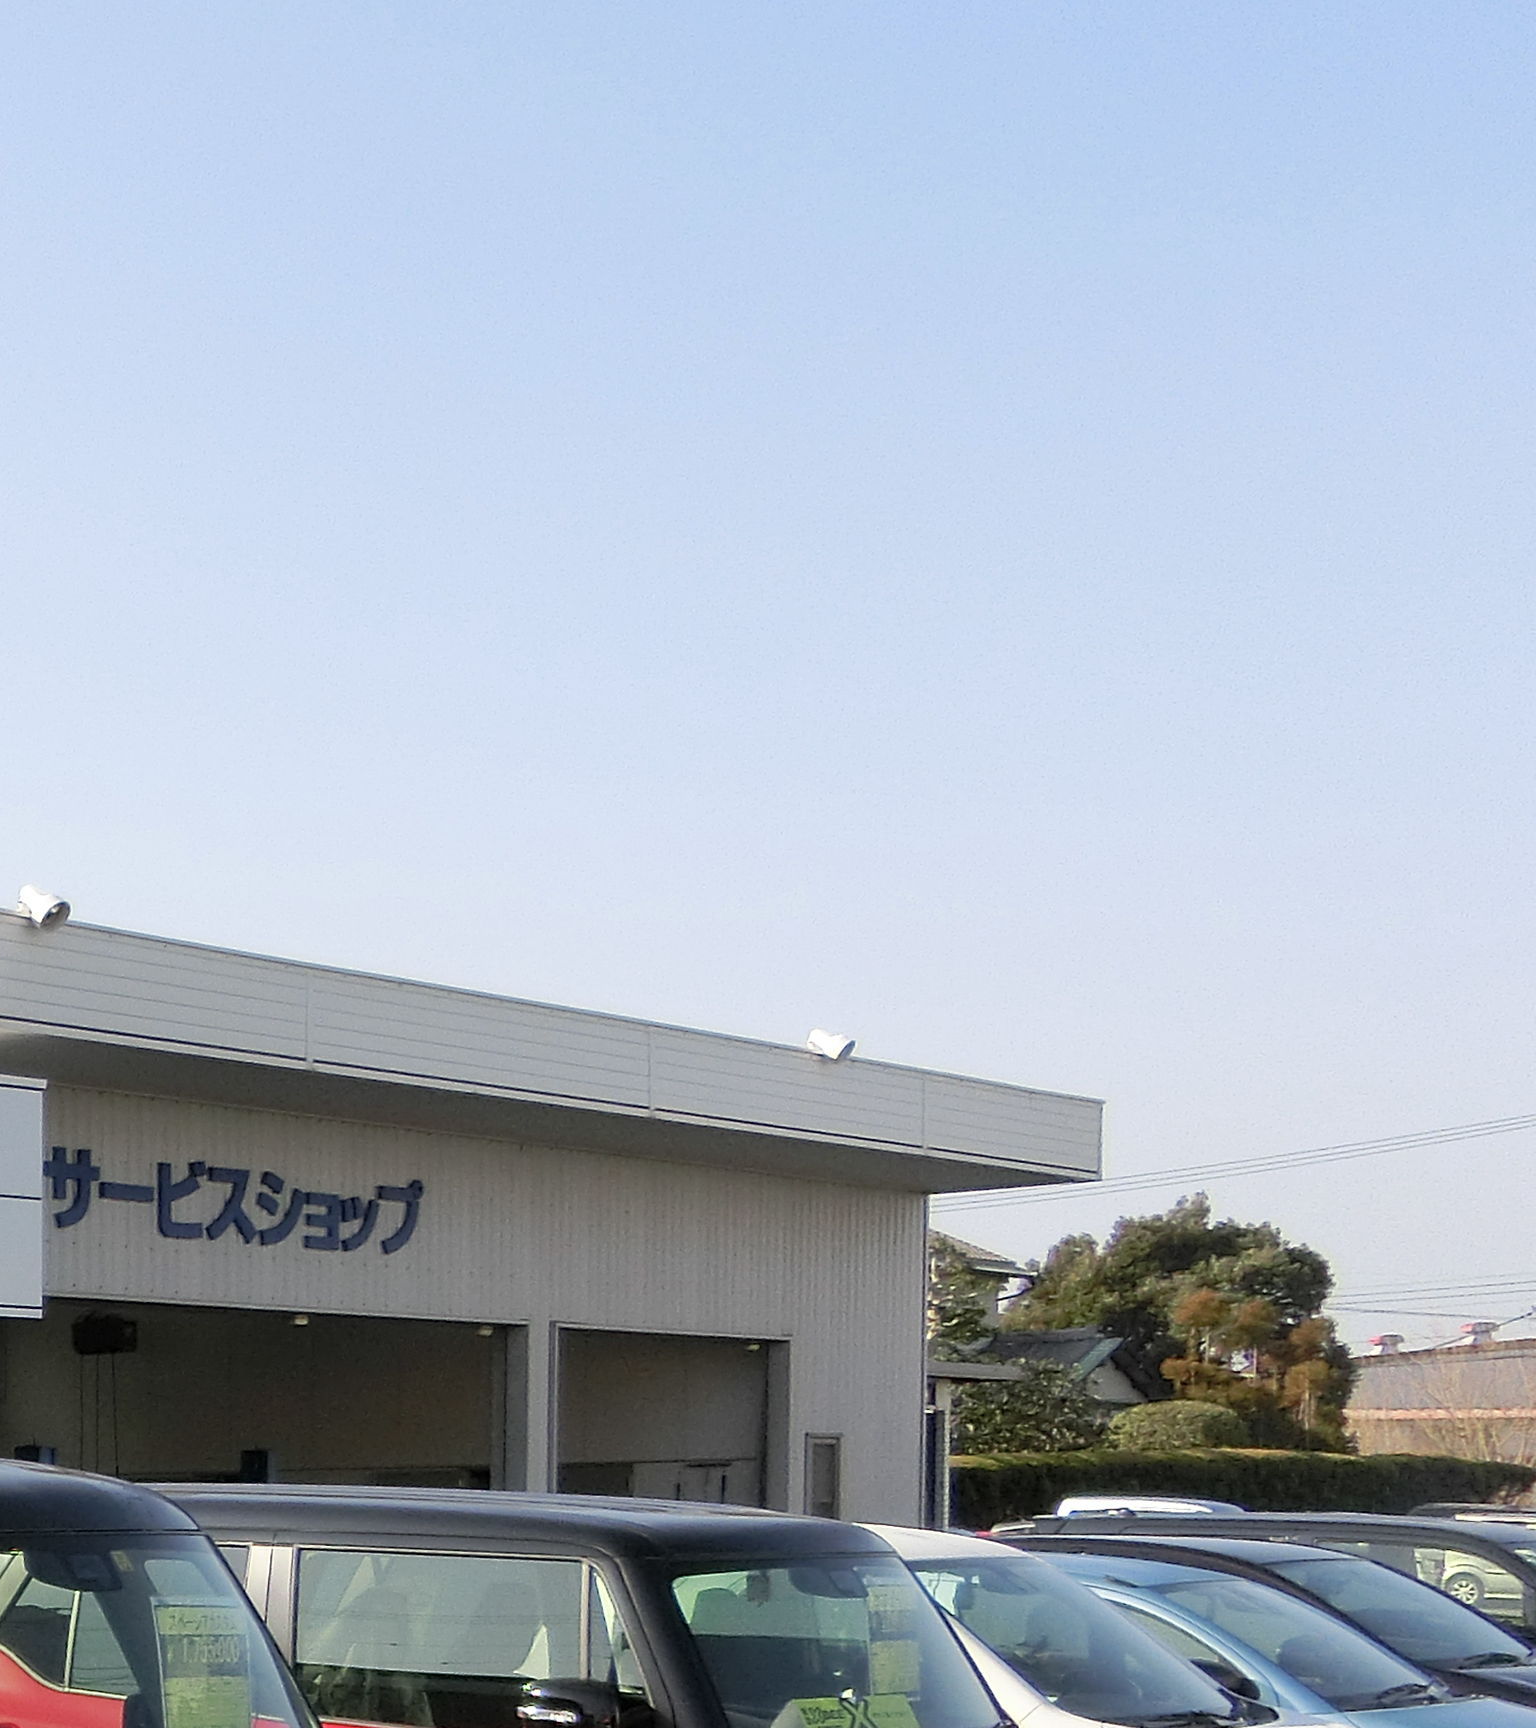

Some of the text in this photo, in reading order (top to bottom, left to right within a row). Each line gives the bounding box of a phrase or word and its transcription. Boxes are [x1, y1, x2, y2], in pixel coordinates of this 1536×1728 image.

[43, 1146, 424, 1254] サービスショップ
